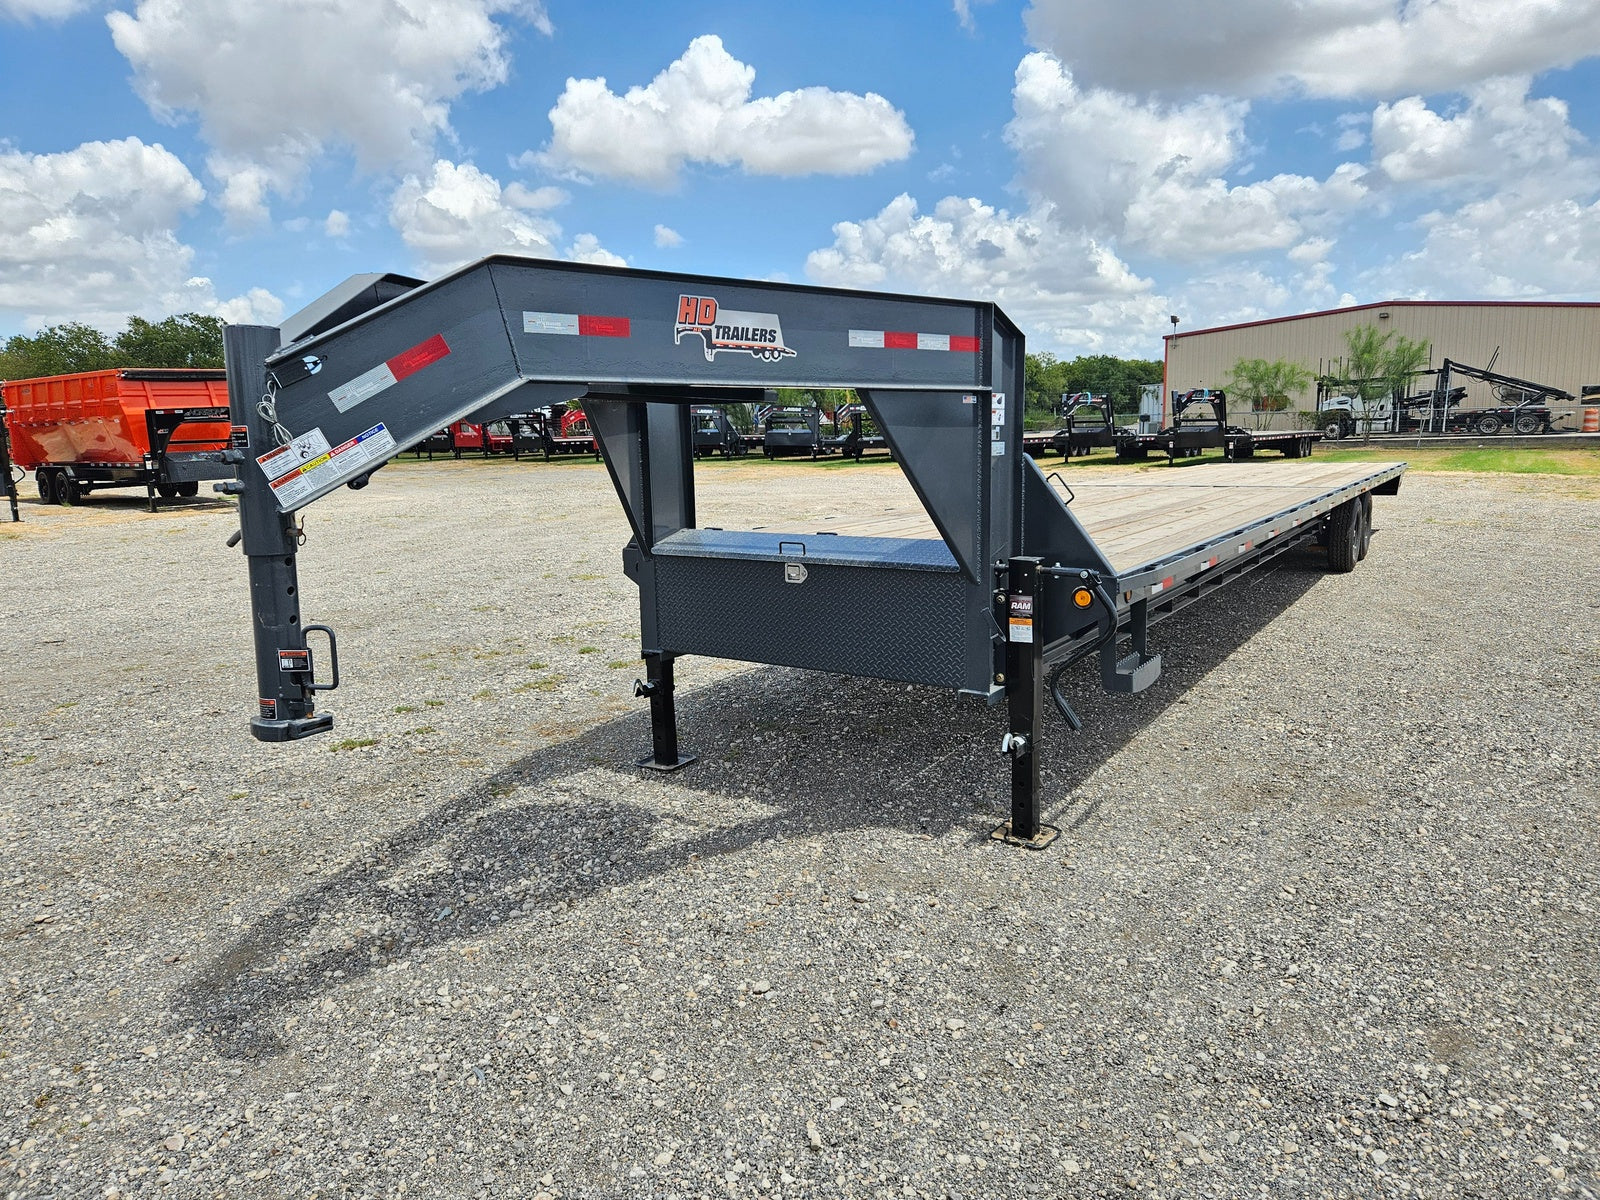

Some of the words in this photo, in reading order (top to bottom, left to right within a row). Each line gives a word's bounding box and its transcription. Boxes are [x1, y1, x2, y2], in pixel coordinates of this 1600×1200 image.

[678, 295, 717, 326] HD
[714, 325, 777, 343] TRAILERS
[361, 427, 380, 440] NOTICE
[334, 440, 356, 454] DANGER
[305, 455, 329, 470] CAUTION
[1010, 602, 1031, 610] RAM
